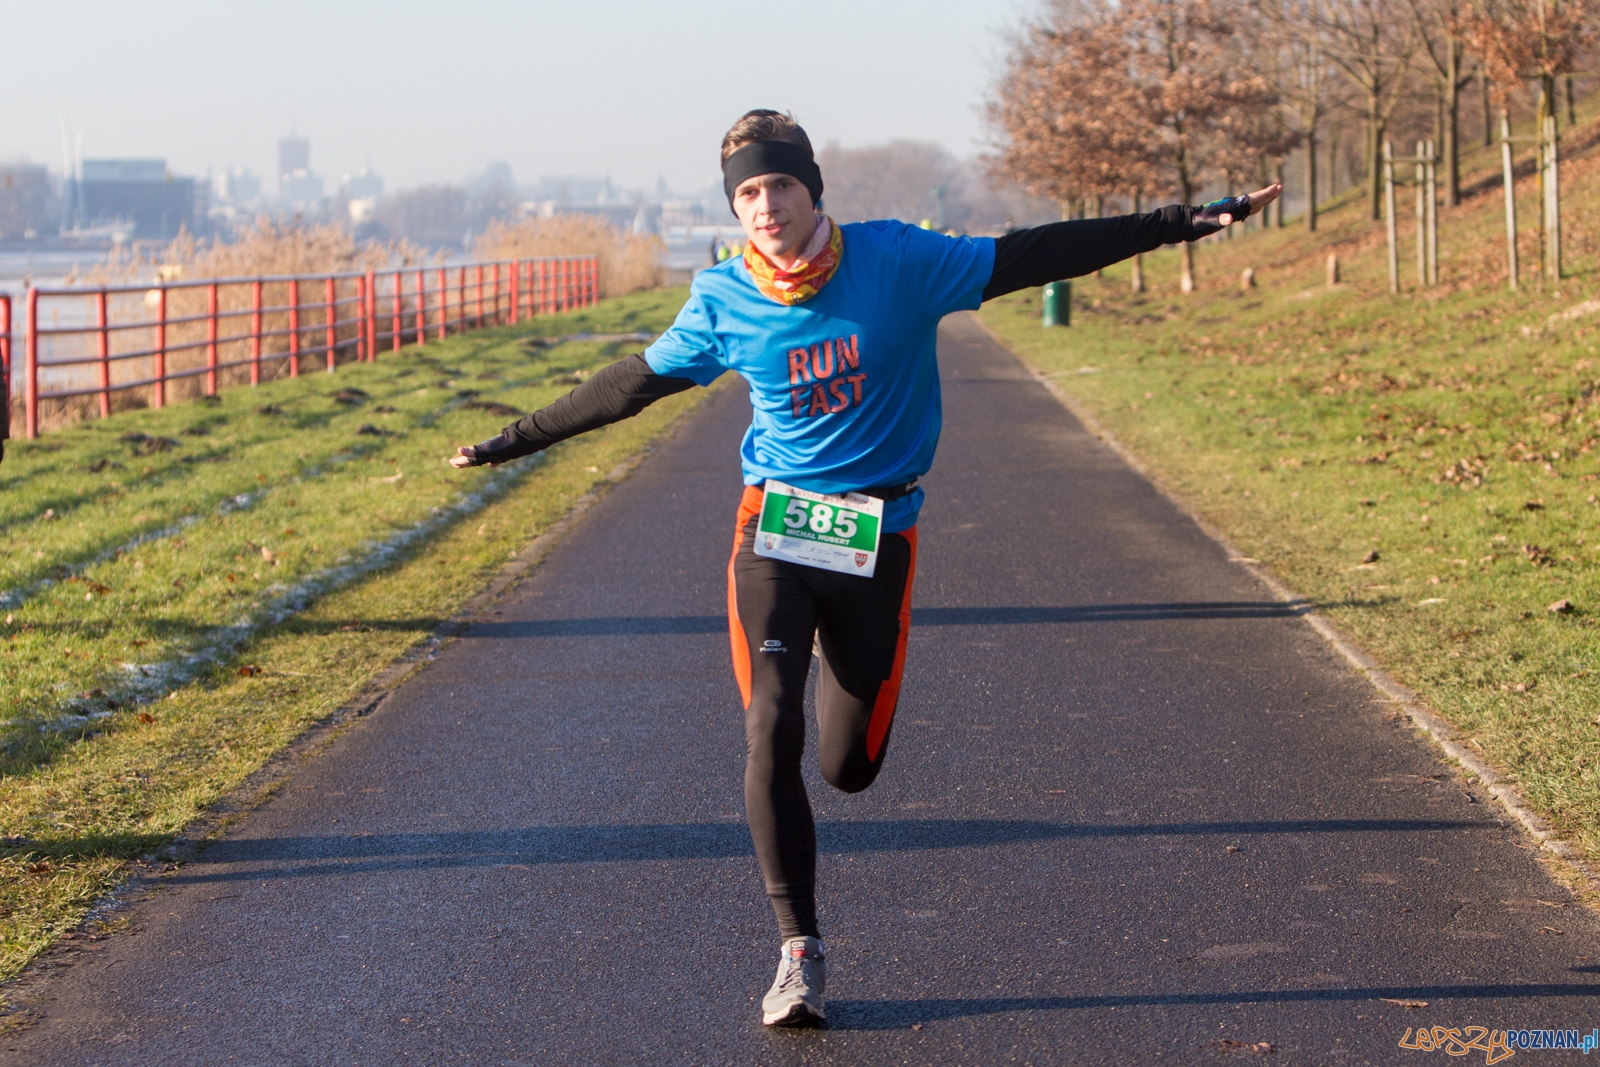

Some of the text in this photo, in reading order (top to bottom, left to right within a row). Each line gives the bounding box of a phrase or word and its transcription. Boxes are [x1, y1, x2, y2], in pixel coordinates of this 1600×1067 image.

[787, 333, 860, 385] RUN
[790, 372, 867, 418] FAST
[783, 498, 859, 538] 585
[818, 534, 851, 546] HUBERT
